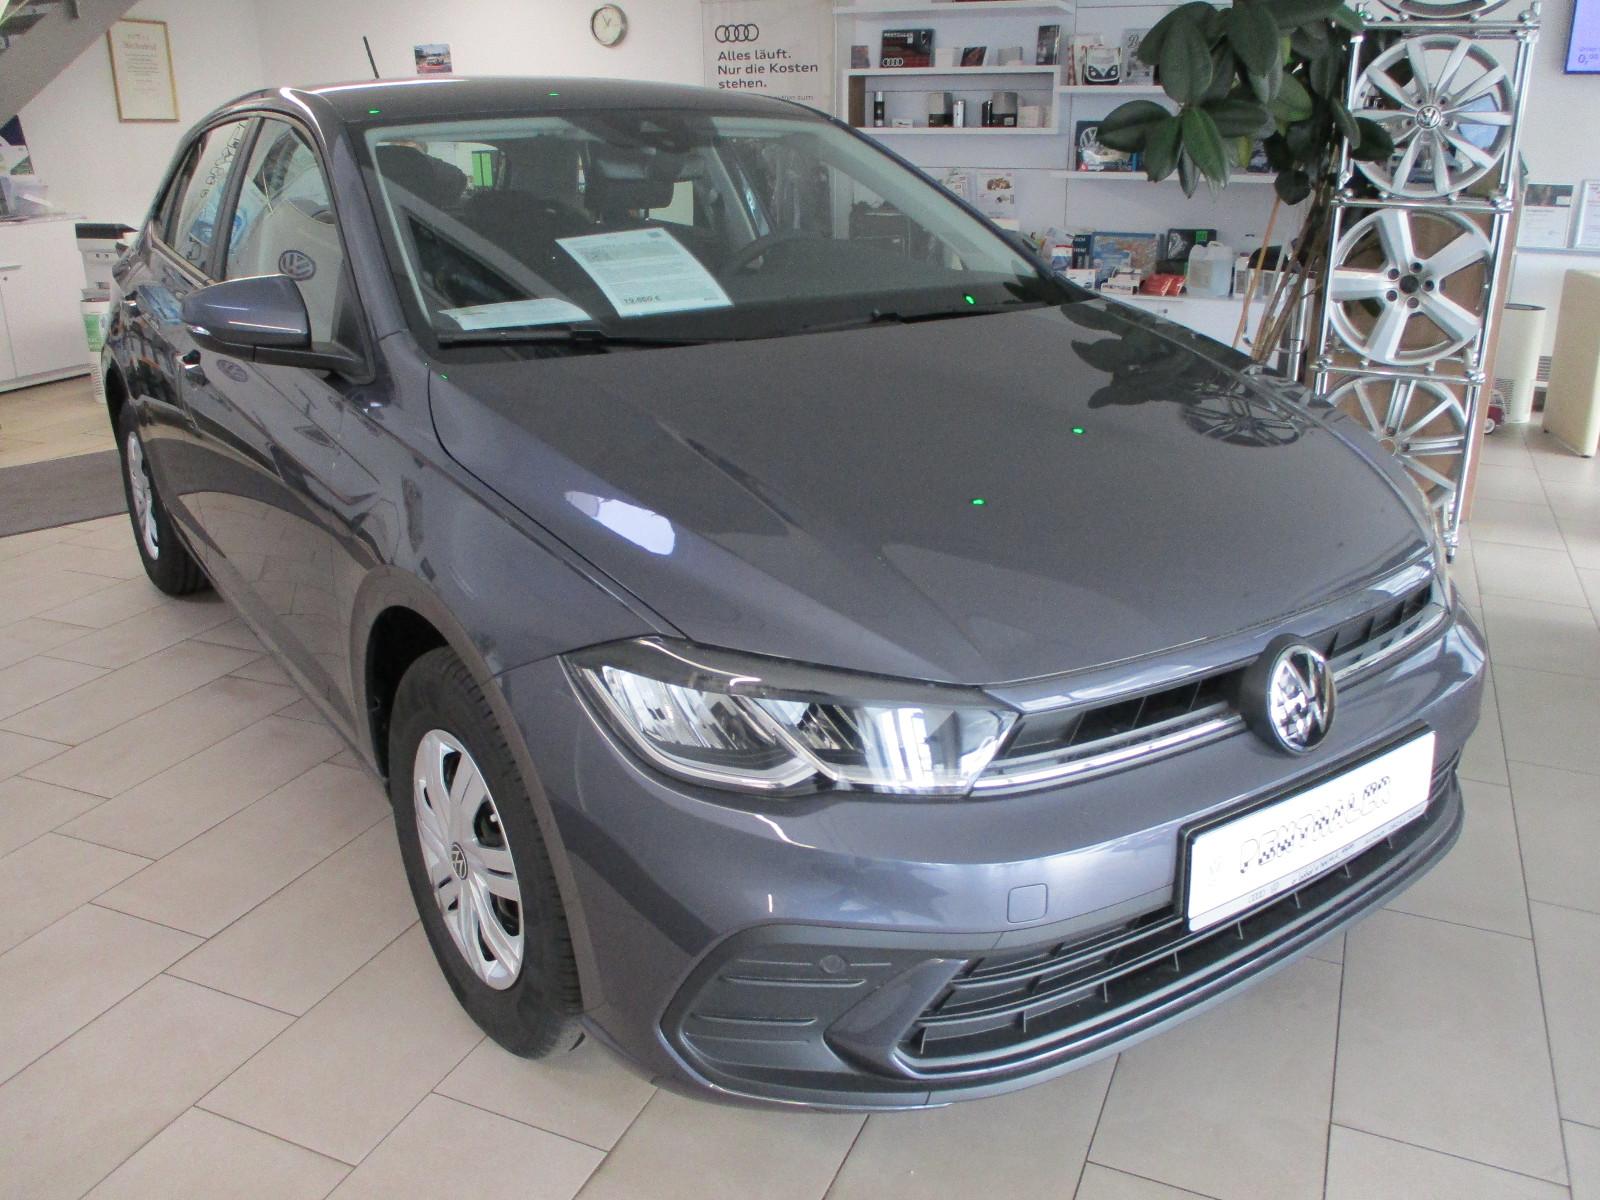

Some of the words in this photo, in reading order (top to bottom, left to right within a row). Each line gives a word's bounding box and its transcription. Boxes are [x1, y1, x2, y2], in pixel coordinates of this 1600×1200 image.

[718, 51, 751, 61] Alles
[755, 48, 791, 60] läuft.
[718, 65, 741, 75] Nur
[745, 64, 765, 74] die
[769, 63, 818, 73] Kosten
[718, 78, 767, 89] stehen.
